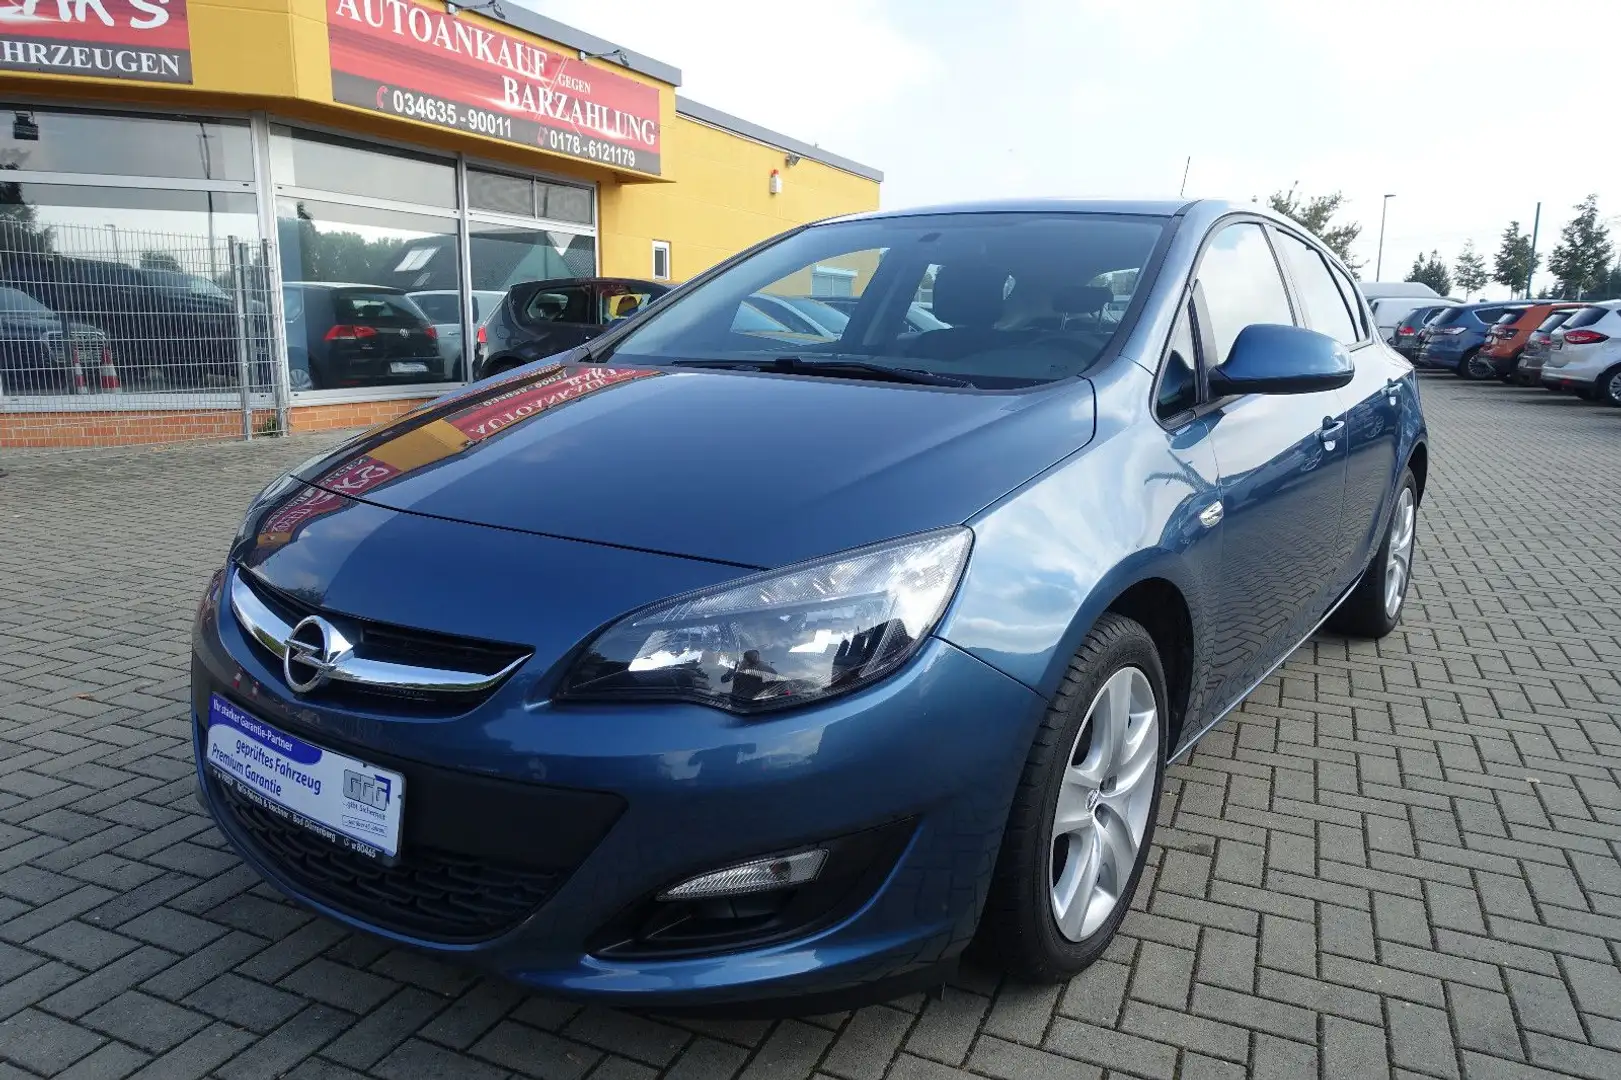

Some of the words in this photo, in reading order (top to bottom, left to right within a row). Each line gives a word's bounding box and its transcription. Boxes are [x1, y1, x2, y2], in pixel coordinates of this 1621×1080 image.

[0, 40, 180, 76] HRZEUGEN
[335, 0, 548, 79] AUTOANKAUF
[502, 75, 656, 146] BARZAHLUNG
[557, 72, 592, 95] GEGEN
[240, 715, 293, 752] Garantie-Partner
[211, 743, 244, 775] Premium
[244, 764, 282, 797] Garantie
[236, 739, 274, 769] geprüftes
[275, 757, 322, 796] Fahrzeug
